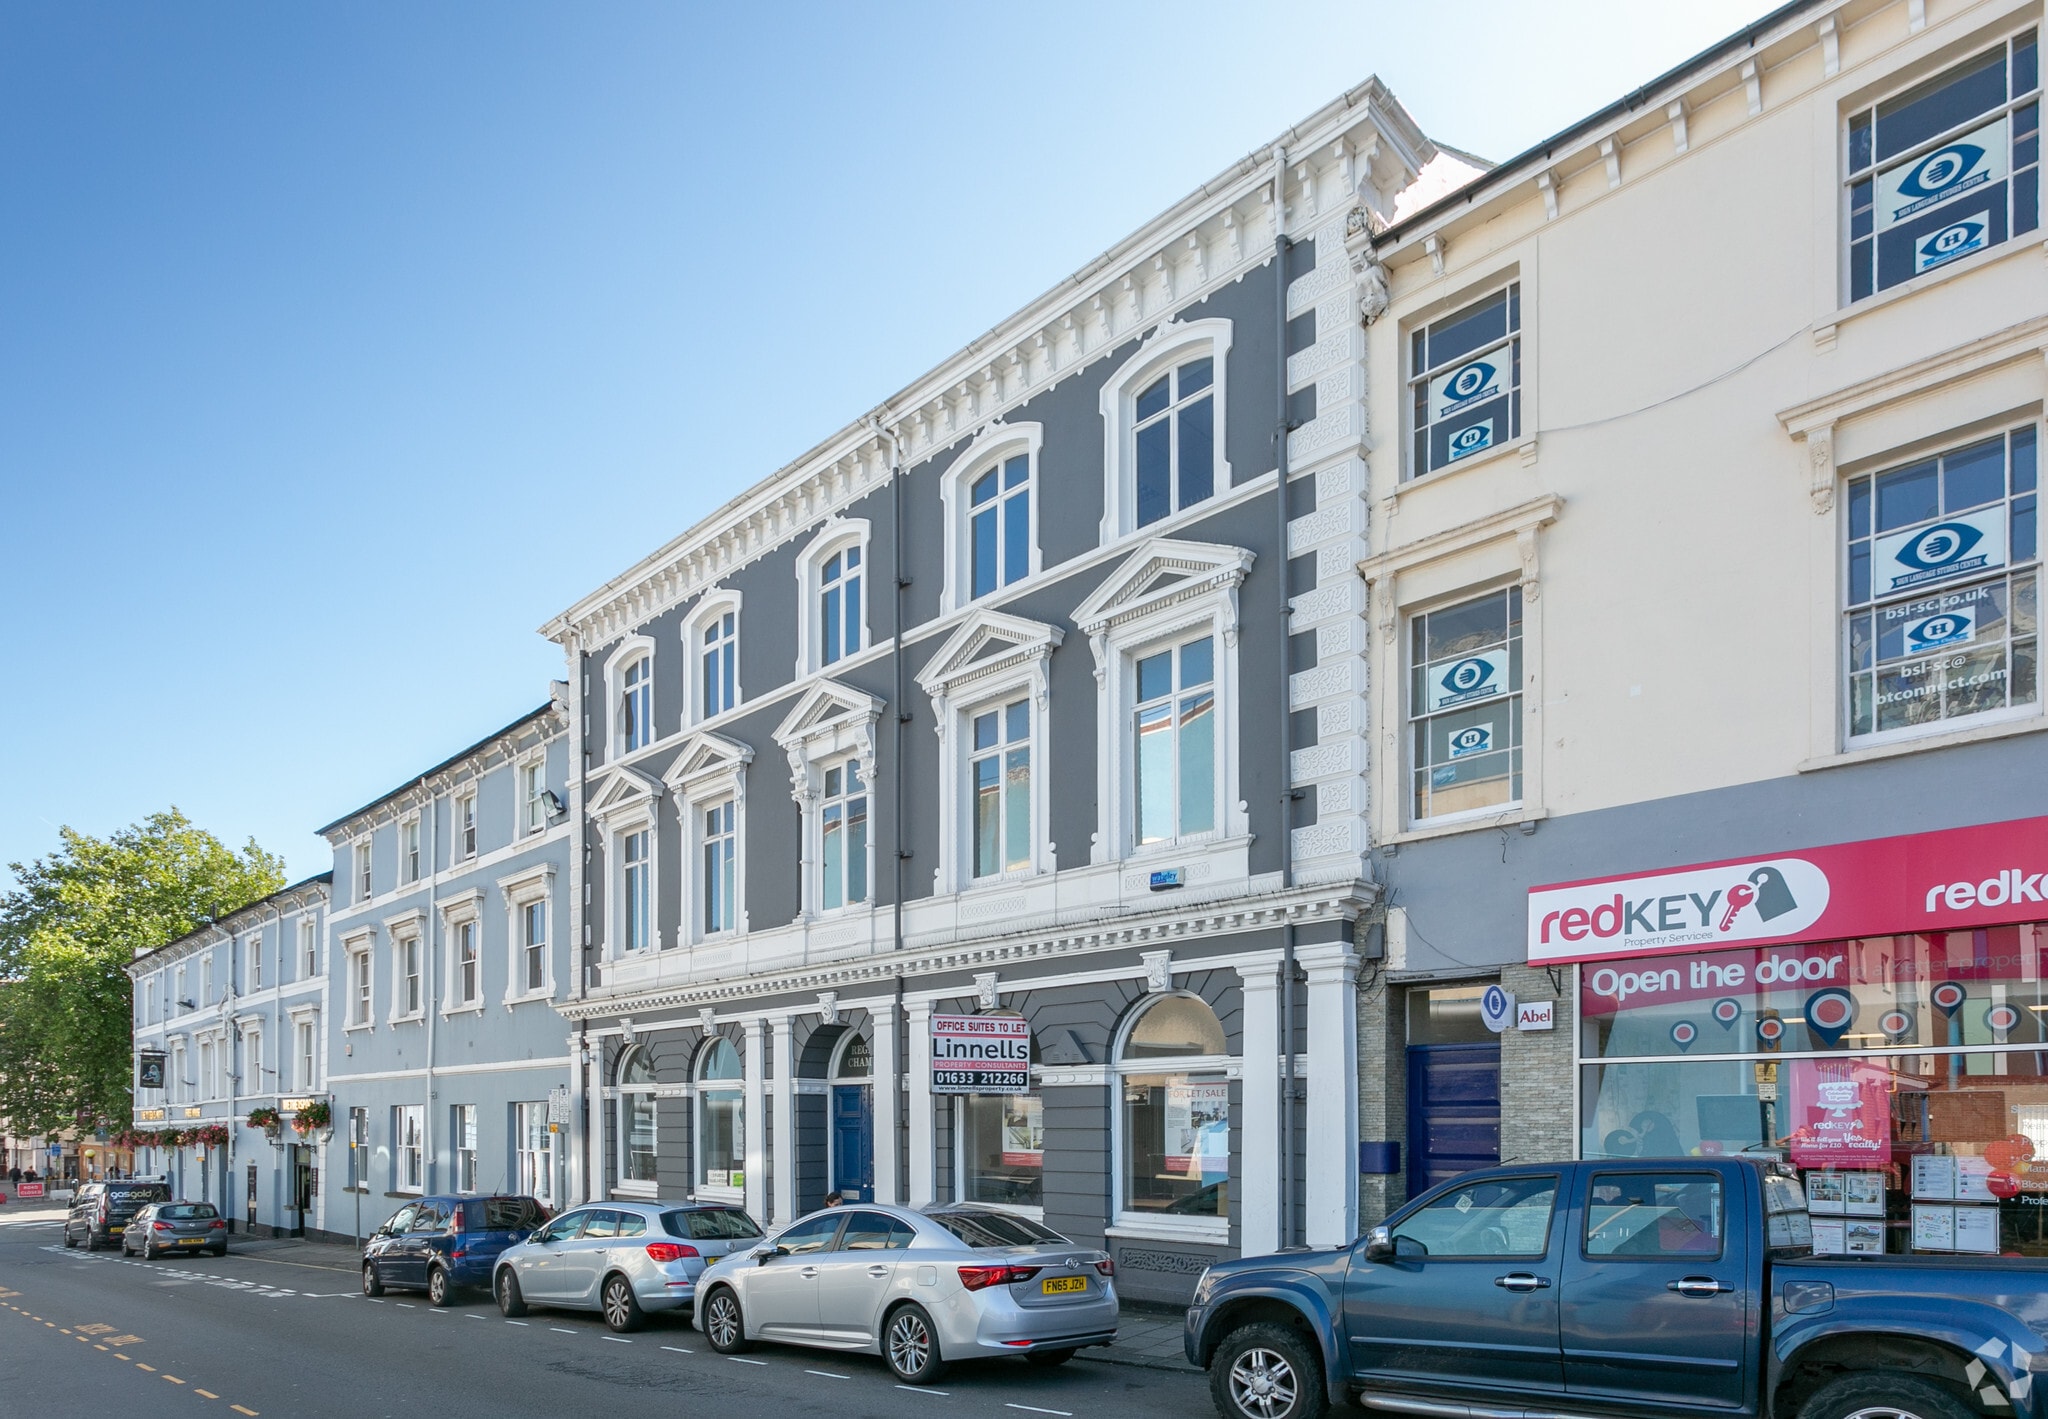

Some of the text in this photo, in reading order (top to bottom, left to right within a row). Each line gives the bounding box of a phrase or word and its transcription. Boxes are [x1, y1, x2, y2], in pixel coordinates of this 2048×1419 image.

[1943, 232, 1961, 247] H
[1466, 433, 1476, 445] H
[1885, 586, 1989, 621] bsl-sc.co.uk
[1930, 623, 1948, 636] H
[1901, 655, 1966, 679] bsl-sc@
[1877, 668, 2007, 705] btconnect.com
[1465, 734, 1476, 744] H
[1926, 868, 2048, 913] redk
[1541, 889, 1723, 944] redKEY
[1624, 931, 1713, 947] Property Services
[1592, 954, 1843, 1001] Open the door
[1520, 1008, 1550, 1024] Abel
[937, 1021, 1026, 1033] OFFICE SUITES TO LET
[933, 1038, 1028, 1059] Linnells
[937, 1072, 1024, 1084] 01633 212266
[1046, 1279, 1084, 1292] FN65 JZH
